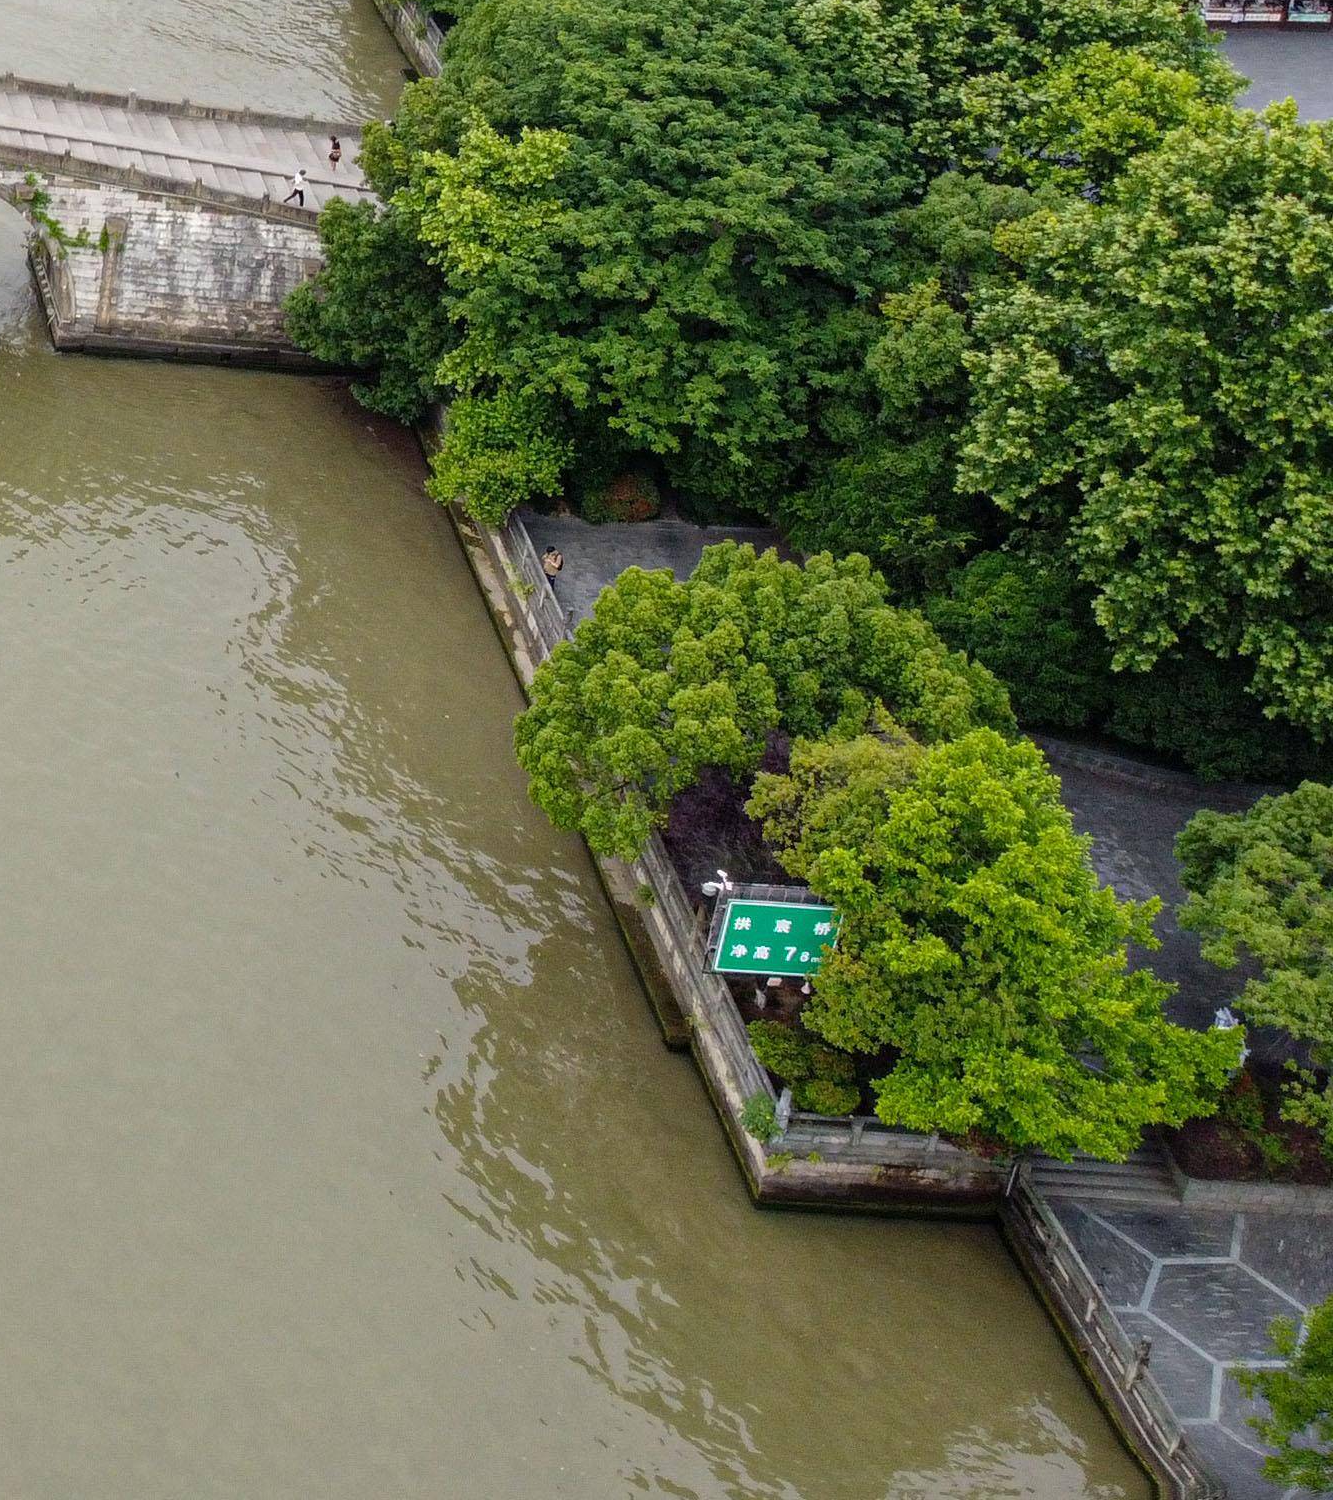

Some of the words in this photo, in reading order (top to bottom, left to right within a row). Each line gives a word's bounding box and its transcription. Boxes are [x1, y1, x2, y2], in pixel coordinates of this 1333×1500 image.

[734, 915, 831, 936] 拱宸桥
[730, 944, 771, 960] 净高
